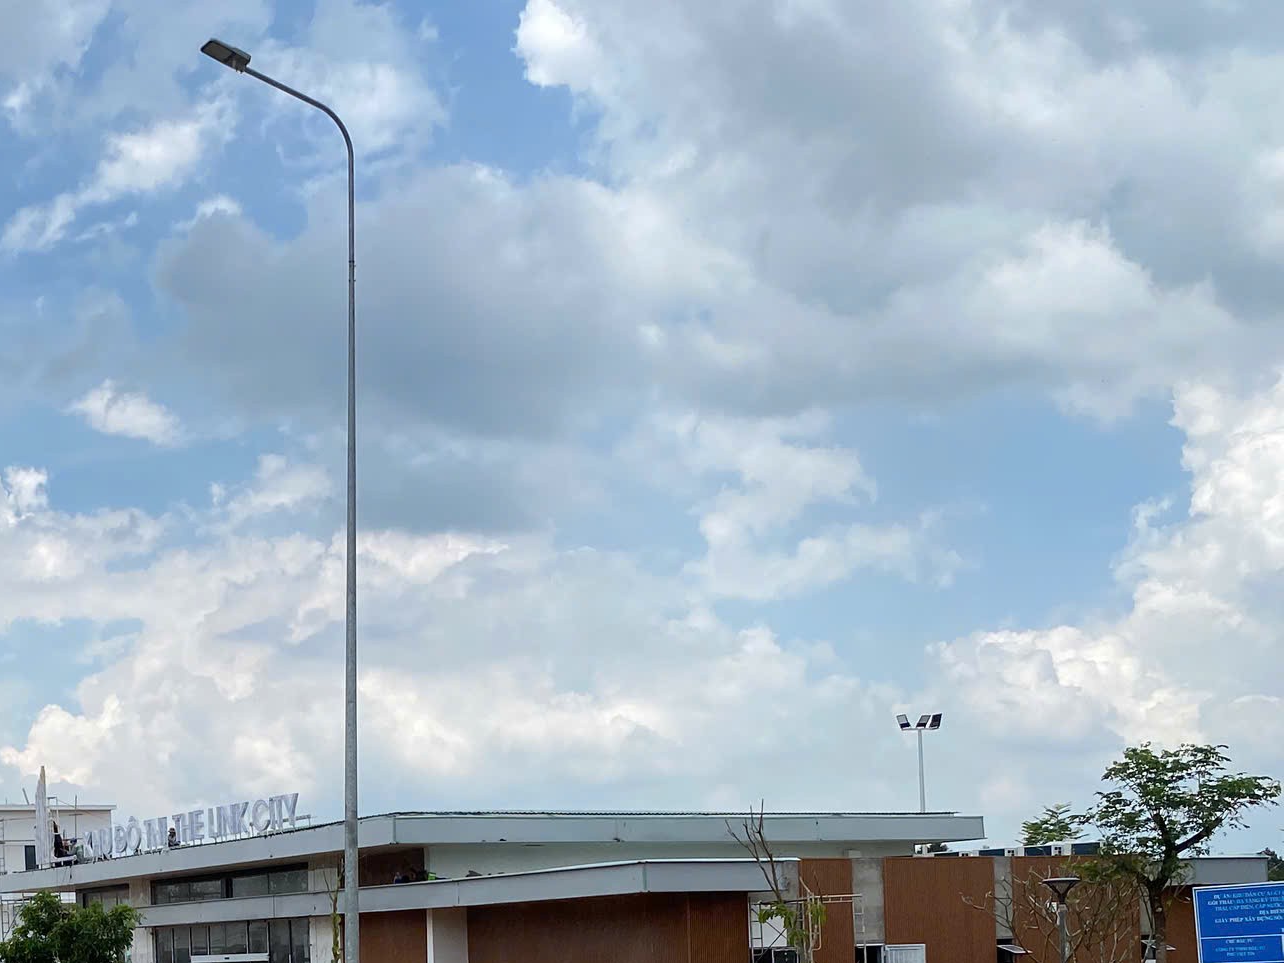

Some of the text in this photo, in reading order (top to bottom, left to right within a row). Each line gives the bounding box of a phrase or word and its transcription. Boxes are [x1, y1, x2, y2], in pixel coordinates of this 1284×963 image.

[172, 810, 205, 842] THE
[208, 801, 250, 838] LINK
[252, 793, 299, 832] CITY
